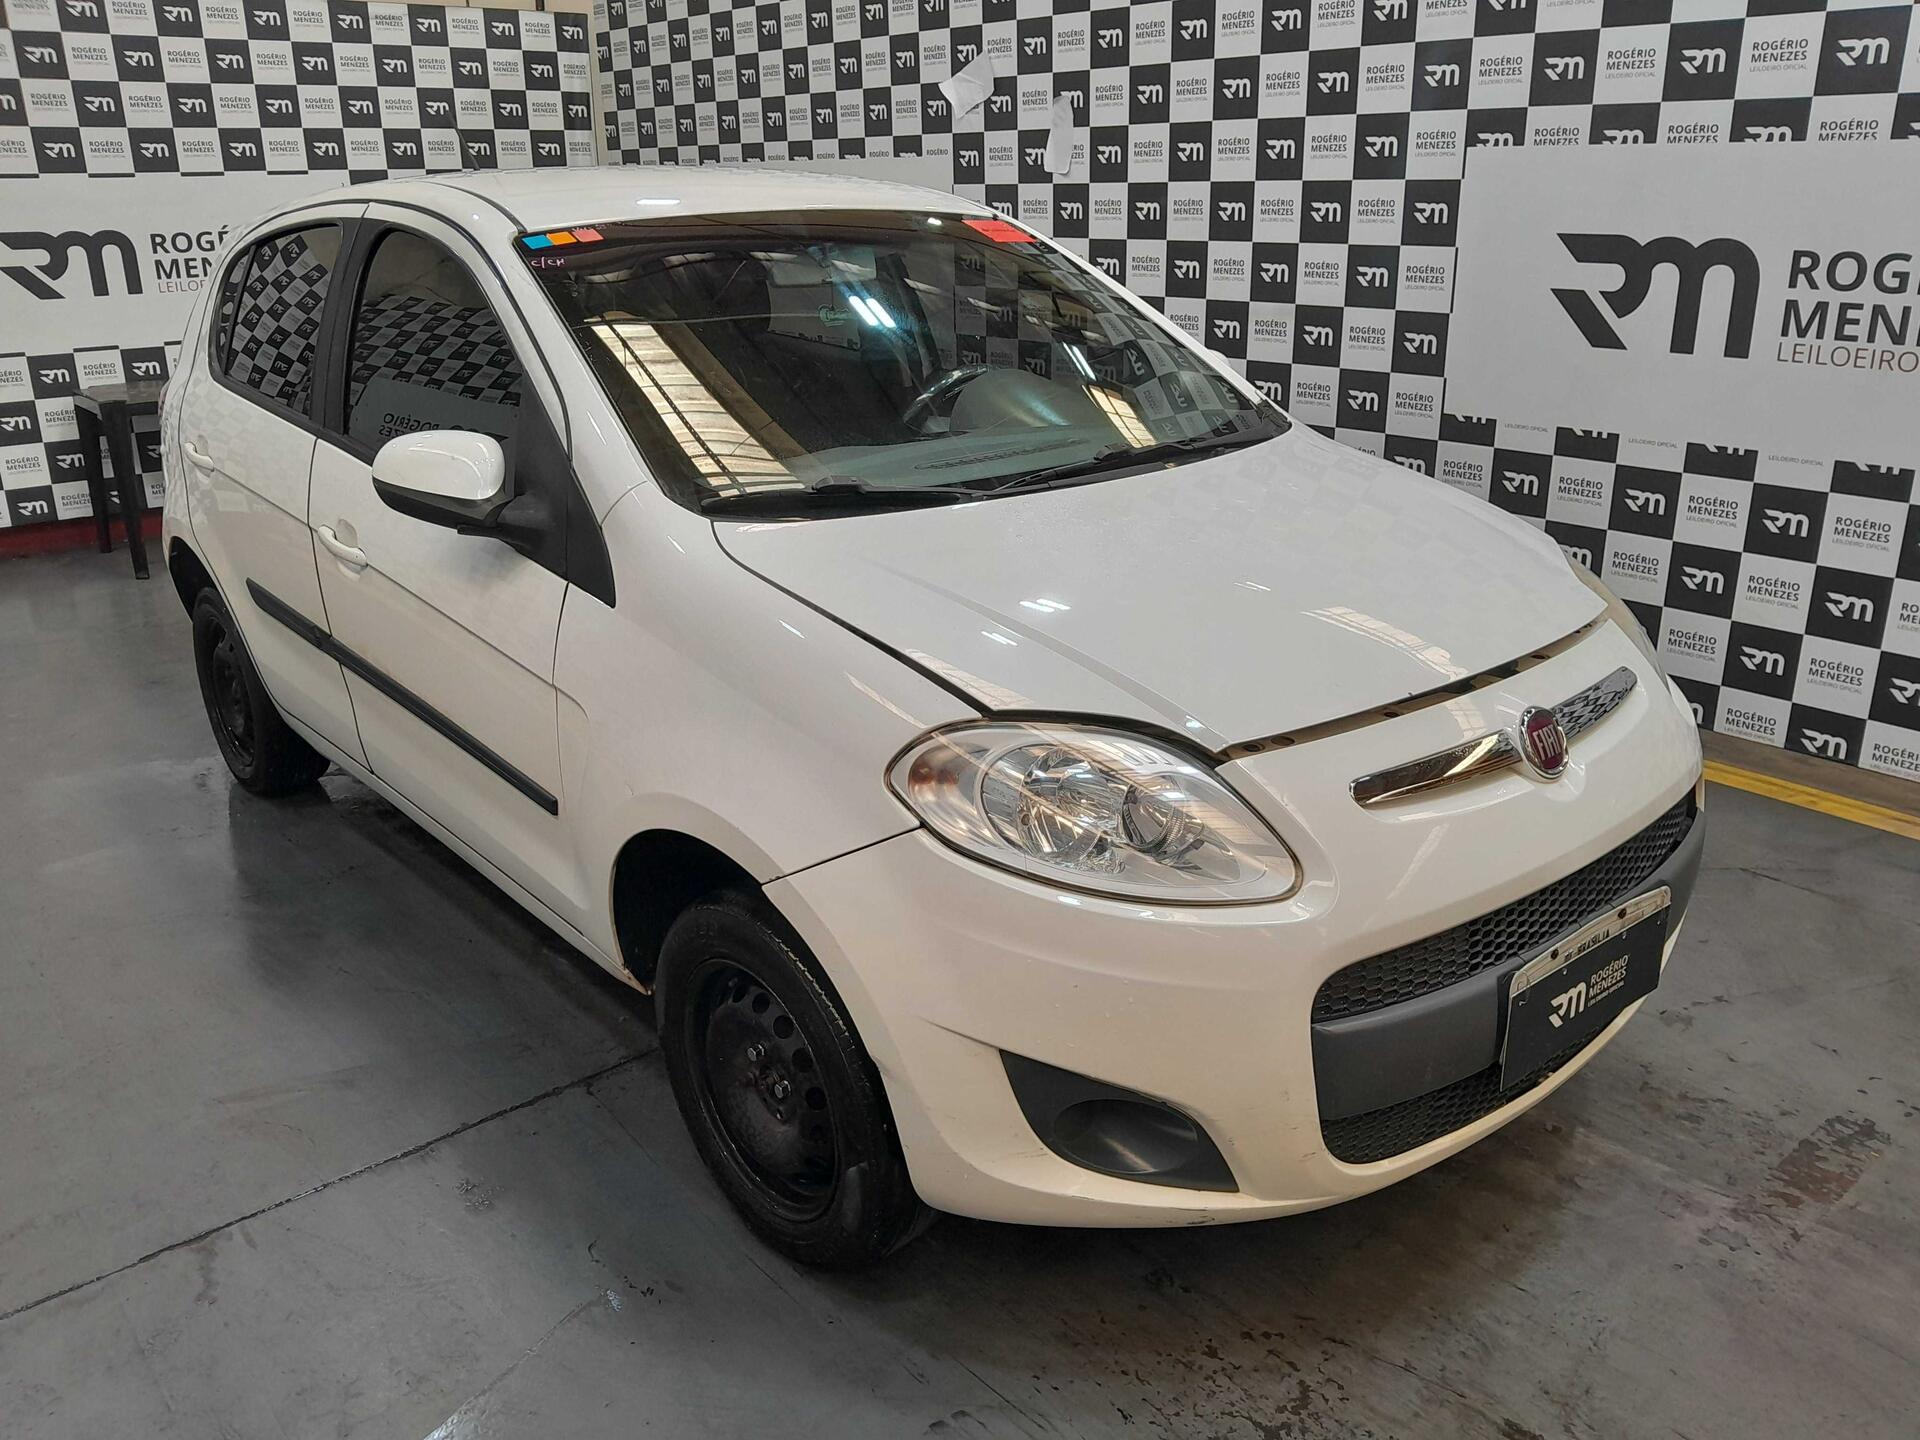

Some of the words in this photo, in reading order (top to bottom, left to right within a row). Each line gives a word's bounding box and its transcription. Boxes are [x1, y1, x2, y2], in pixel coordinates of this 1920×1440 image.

[1752, 37, 1809, 51] ROGÉRIO
[1607, 47, 1656, 60] ROGÉRIO
[1750, 50, 1807, 63] MENEZES
[1479, 56, 1523, 67] ROGÉRIO
[1606, 59, 1656, 70] MENEZES
[1366, 63, 1405, 75] ROGÉRIO
[1478, 66, 1522, 77] MENEZES
[1366, 73, 1405, 84] MENEZES
[1534, 126, 1579, 137] ROGÉRIO
[1668, 122, 1718, 134] ROGÉRIO
[1820, 118, 1878, 131] ROGÉRIO
[1416, 129, 1457, 140] ROGÉRIO
[1415, 140, 1456, 150] MENEZES
[1406, 264, 1445, 275] ROGÉRIO
[1788, 250, 1920, 294] ROG
[1405, 274, 1445, 284] MENEZES
[1780, 299, 1920, 347] MEN
[1777, 341, 1919, 372] LEILOEIRO
[1395, 392, 1434, 403] ROGÉRIO
[1395, 400, 1433, 412] MENEZES
[1443, 460, 1483, 472] ROGÉRIO
[1442, 470, 1482, 482] MENEZES
[1559, 476, 1603, 490] ROGÉRIO
[1558, 485, 1602, 500] MENEZES
[1689, 495, 1738, 509] ROGÉRIO
[1687, 505, 1737, 520] MENEZES
[1835, 516, 1891, 533] ROGÉRIO
[1833, 527, 1890, 543] MENEZES
[1613, 551, 1659, 566] ROGÉRIO
[1612, 560, 1658, 575] MENEZES
[1749, 575, 1800, 591] ROGÉRIO
[1747, 585, 1799, 601] MENEZES
[1669, 628, 1717, 645] ROGÉRIO
[1667, 636, 1716, 655] MENEZES
[1810, 658, 1864, 676] ROGÉRIO
[1808, 667, 1863, 687] MENEZES
[1727, 707, 1777, 726] ROGÉRIO
[1725, 716, 1775, 736] MENEZES
[1532, 724, 1562, 761] FIAT
[1590, 954, 1628, 986] ROGÉRIO
[1589, 966, 1627, 999] MENEZES
